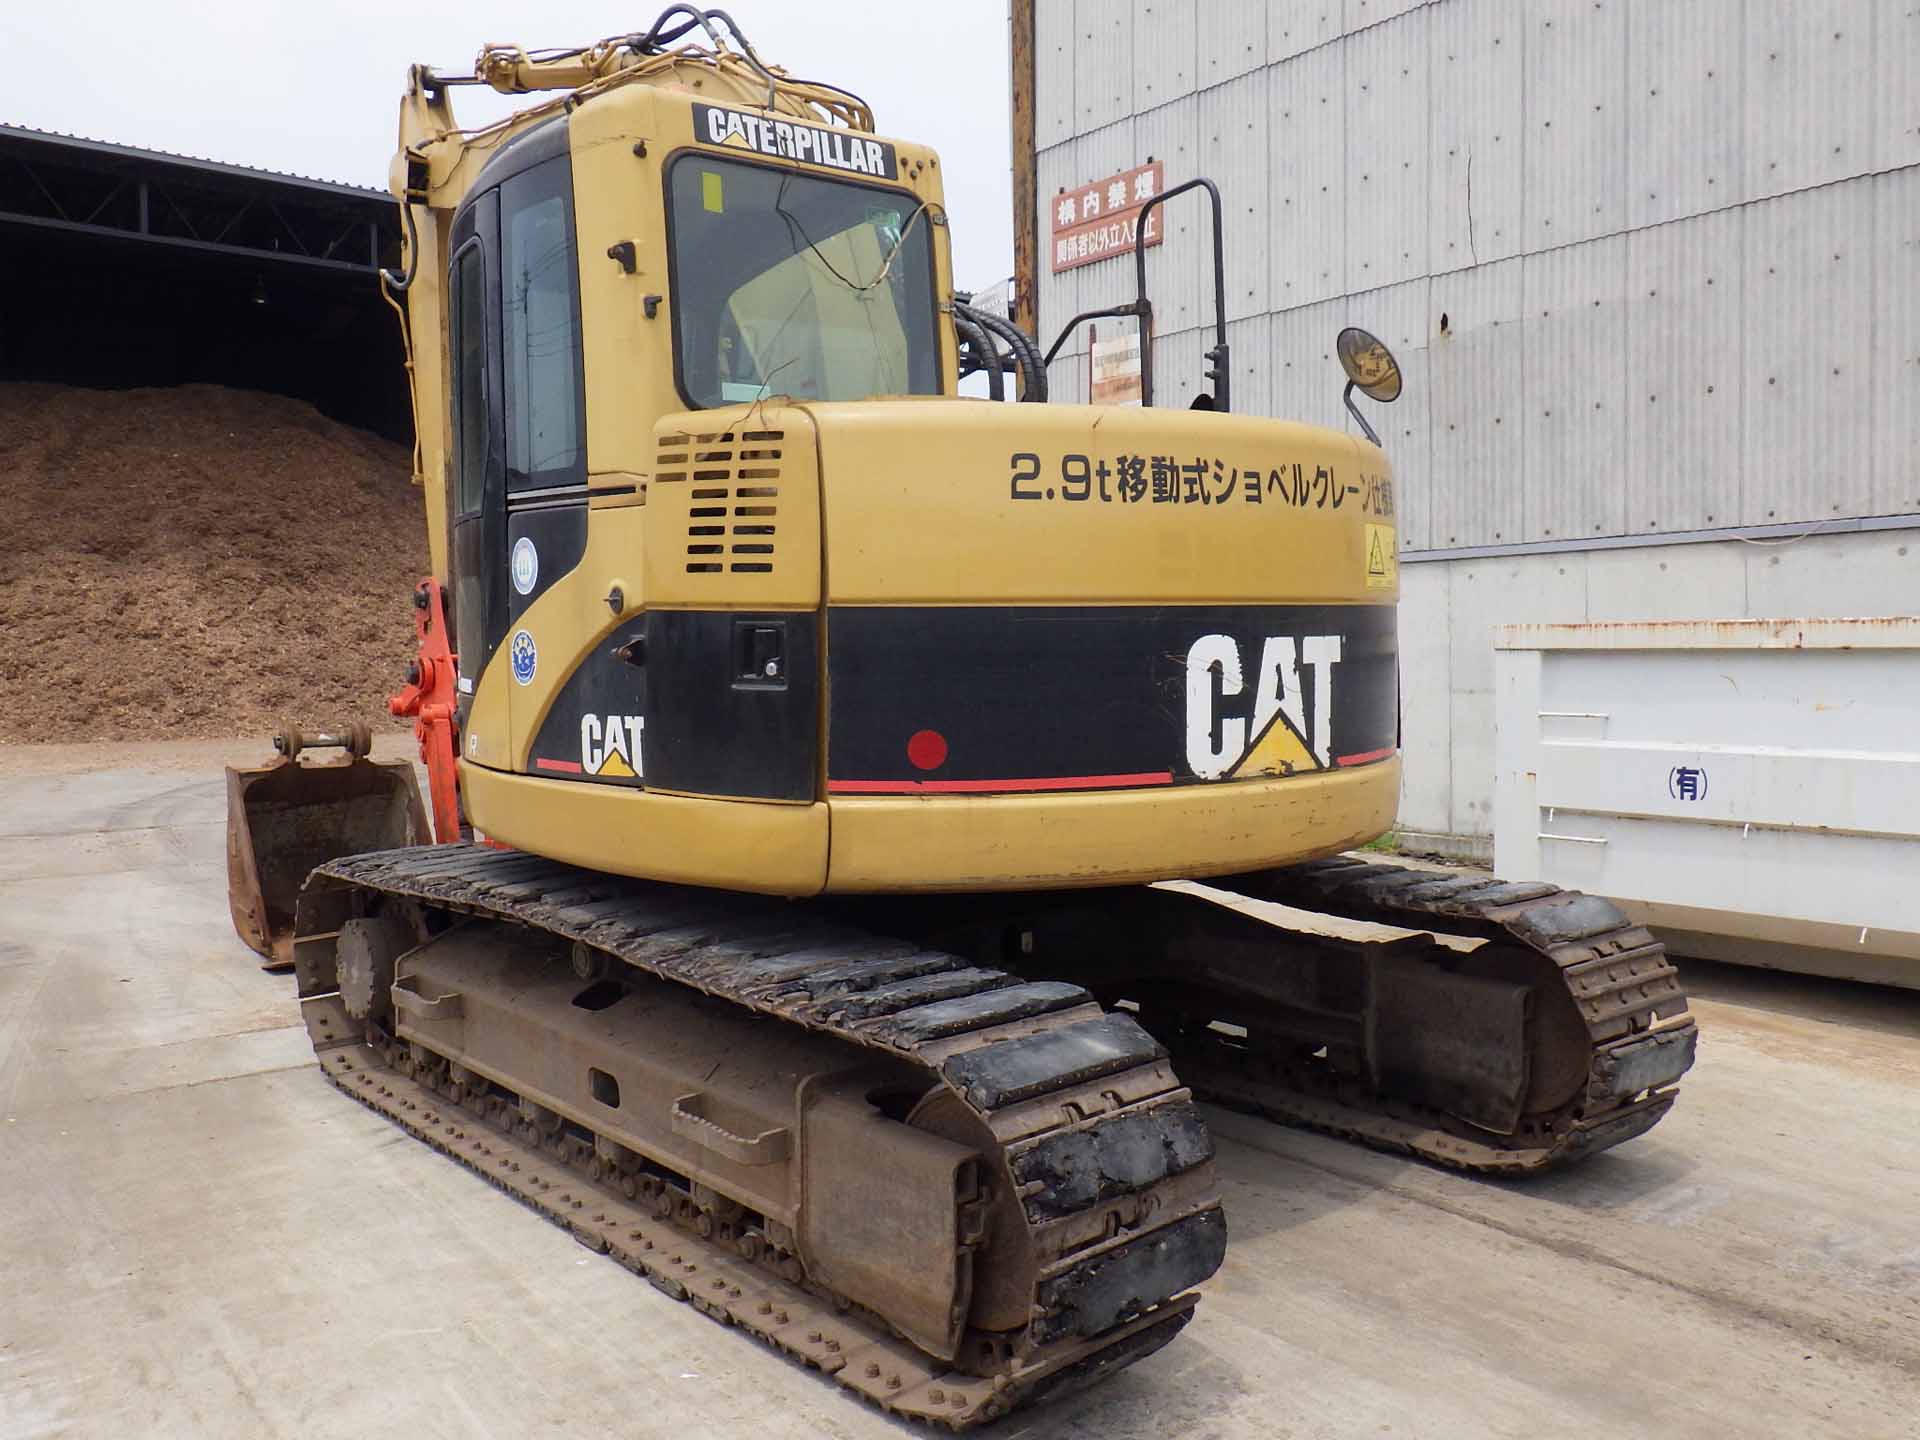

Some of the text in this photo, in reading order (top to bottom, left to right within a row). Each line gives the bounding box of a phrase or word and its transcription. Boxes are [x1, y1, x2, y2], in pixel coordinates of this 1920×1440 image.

[707, 107, 886, 176] CATERPILLAR
[1186, 634, 1342, 780] CAT
[581, 713, 645, 778] CAT
[1669, 766, 1708, 801] (有)
